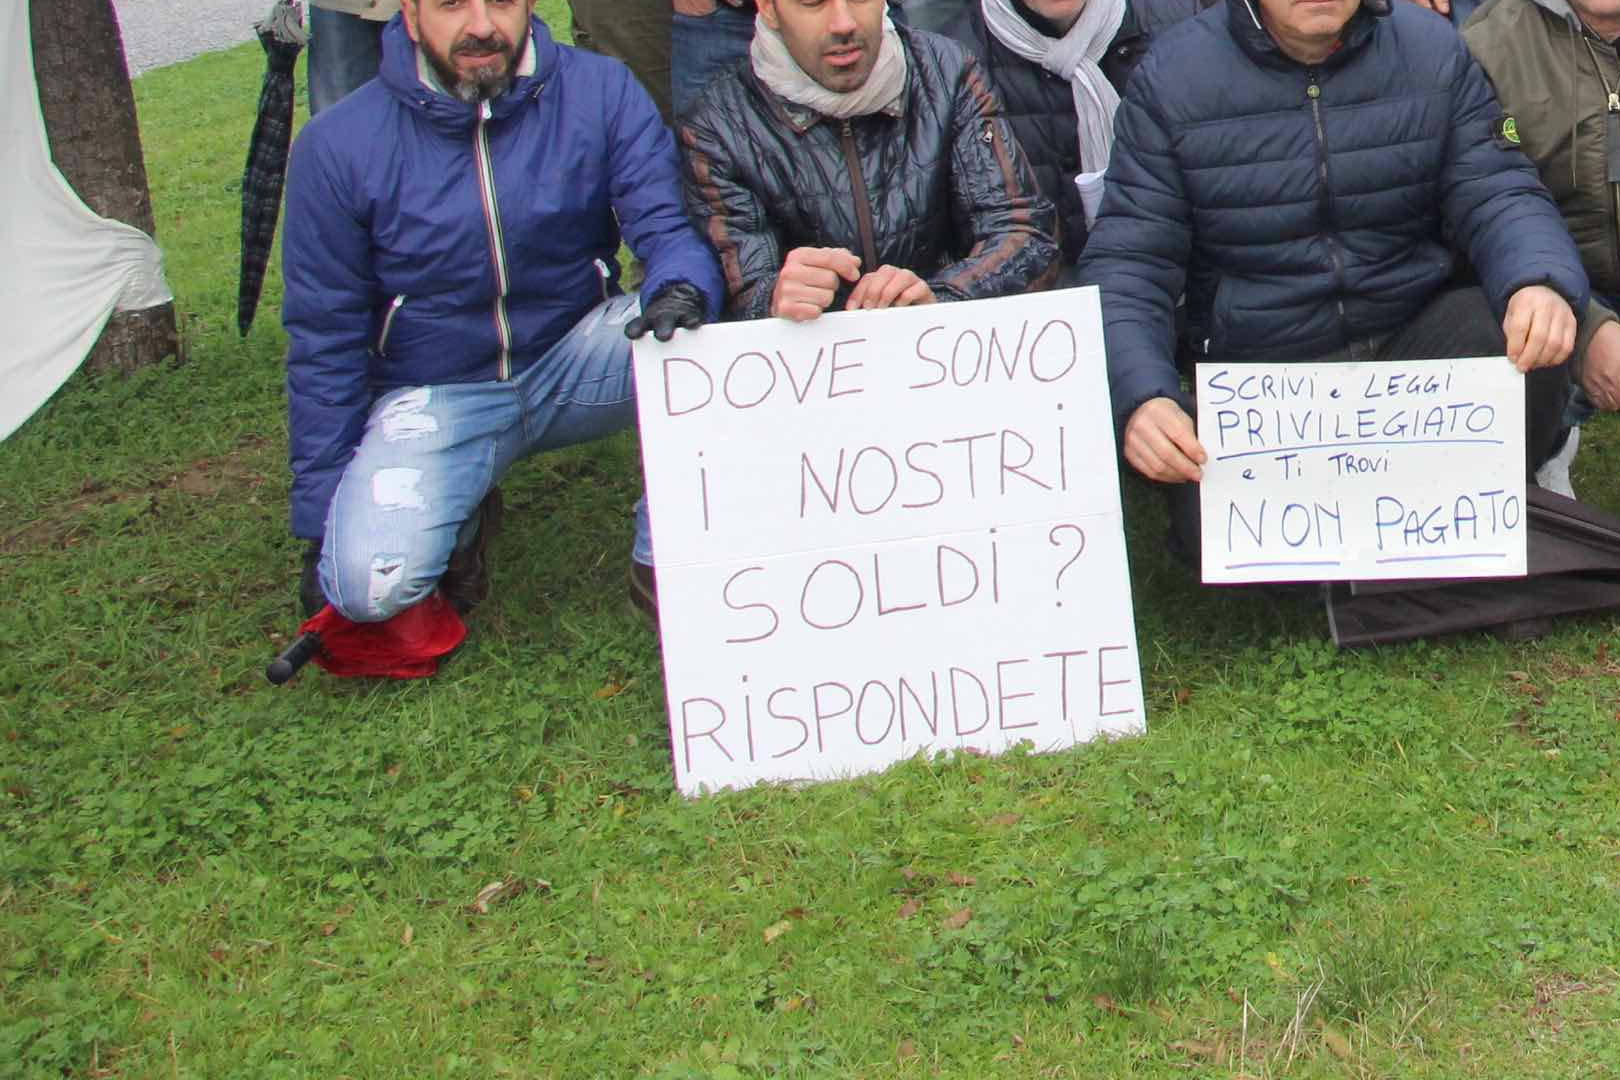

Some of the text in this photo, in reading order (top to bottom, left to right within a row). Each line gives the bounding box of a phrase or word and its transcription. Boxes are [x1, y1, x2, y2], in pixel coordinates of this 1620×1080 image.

[662, 319, 1077, 417] DOVE SONO
[1329, 387, 1342, 399] e
[1217, 402, 1496, 448] PRIVILEGIATO
[1242, 468, 1257, 481] e
[1227, 489, 1520, 553] NON PAGATO
